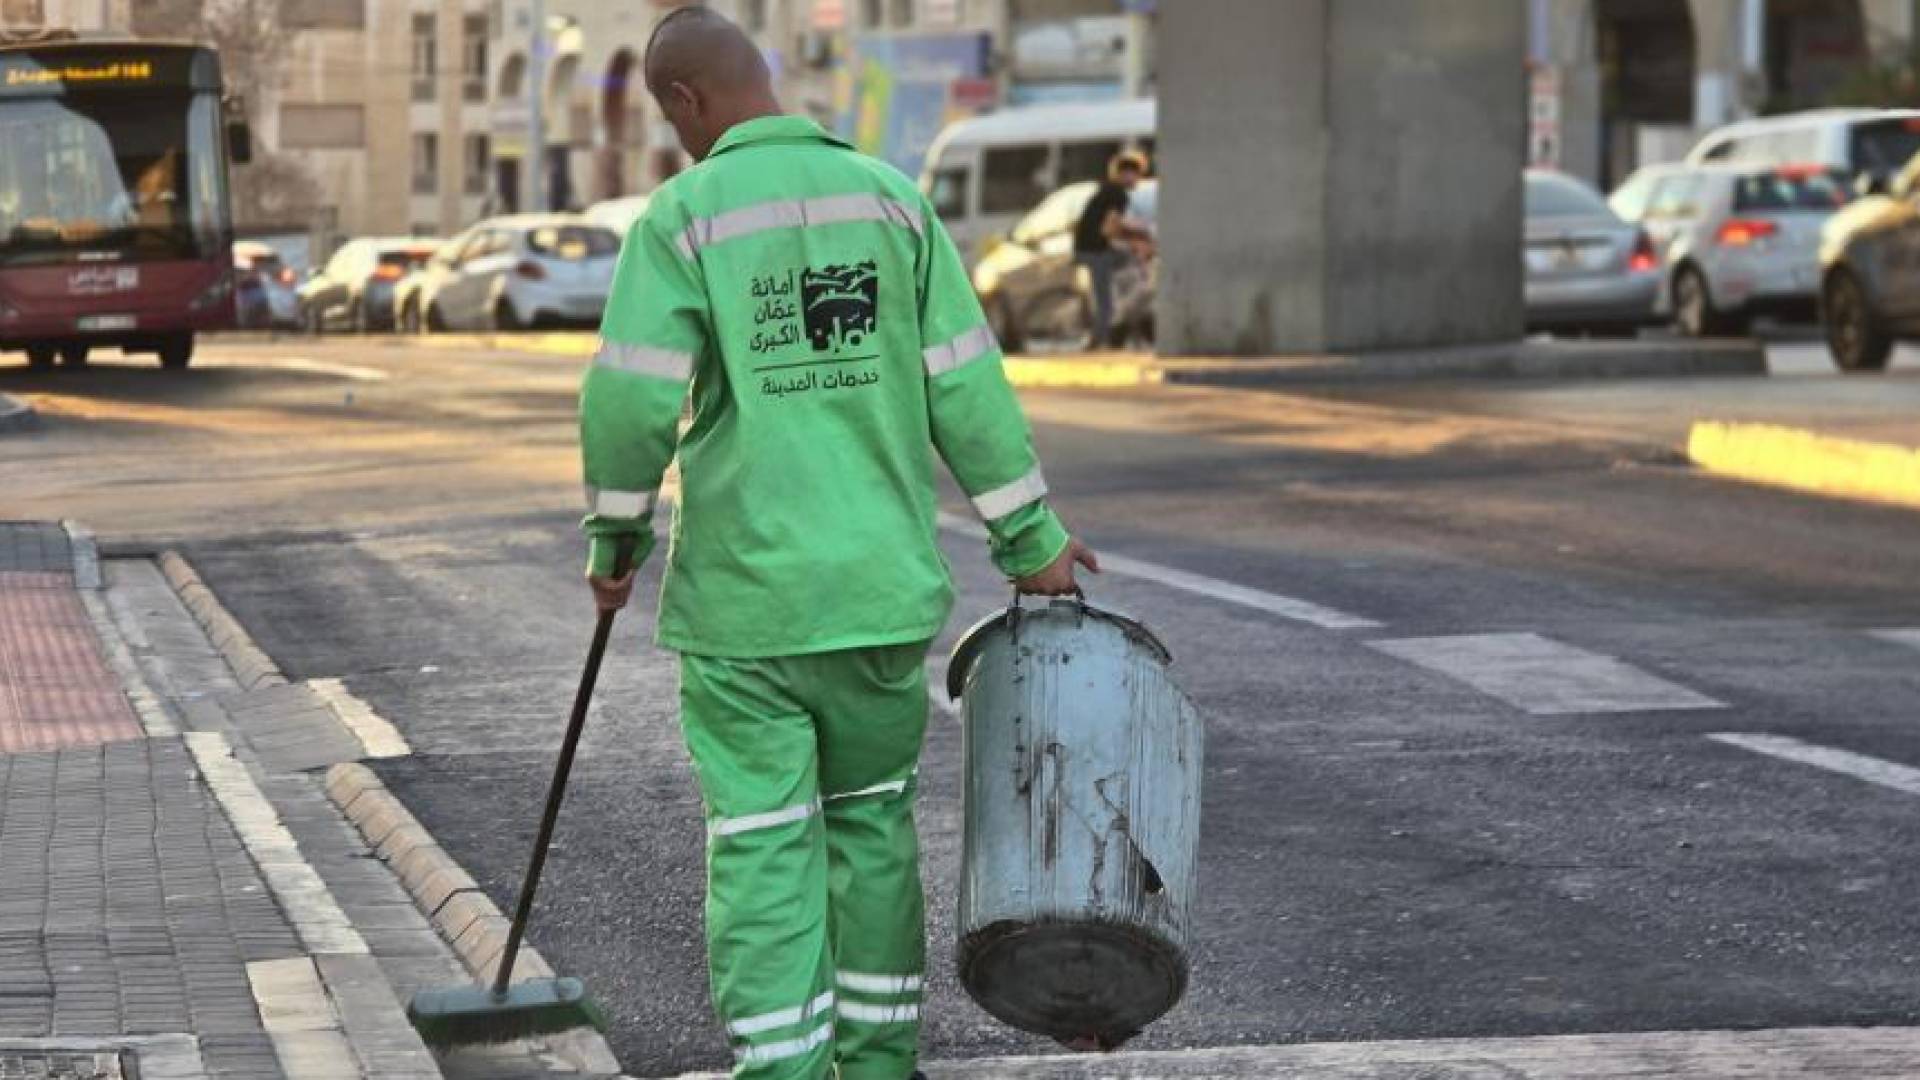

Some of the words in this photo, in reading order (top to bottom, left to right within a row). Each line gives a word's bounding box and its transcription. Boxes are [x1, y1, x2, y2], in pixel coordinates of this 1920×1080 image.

[750, 323, 800, 352] الكبرى
[761, 371, 817, 397] المدينة
[823, 369, 879, 389] خدمات
